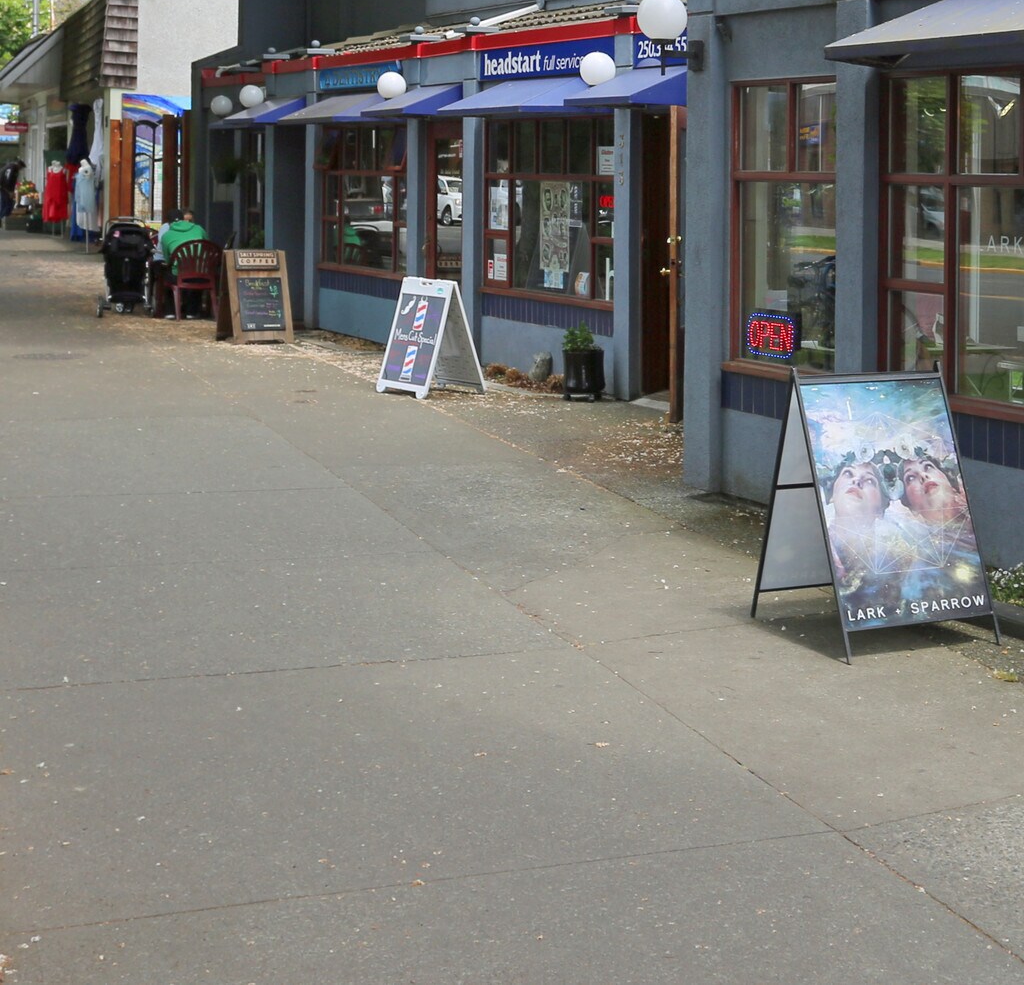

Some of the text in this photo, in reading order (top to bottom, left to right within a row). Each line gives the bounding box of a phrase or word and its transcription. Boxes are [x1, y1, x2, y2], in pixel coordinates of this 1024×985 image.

[484, 50, 542, 76] headstart
[543, 55, 556, 71] full
[418, 331, 438, 349] Special
[750, 320, 792, 352] OPEN
[847, 606, 886, 622] LARK
[910, 594, 985, 614] SPARROW
